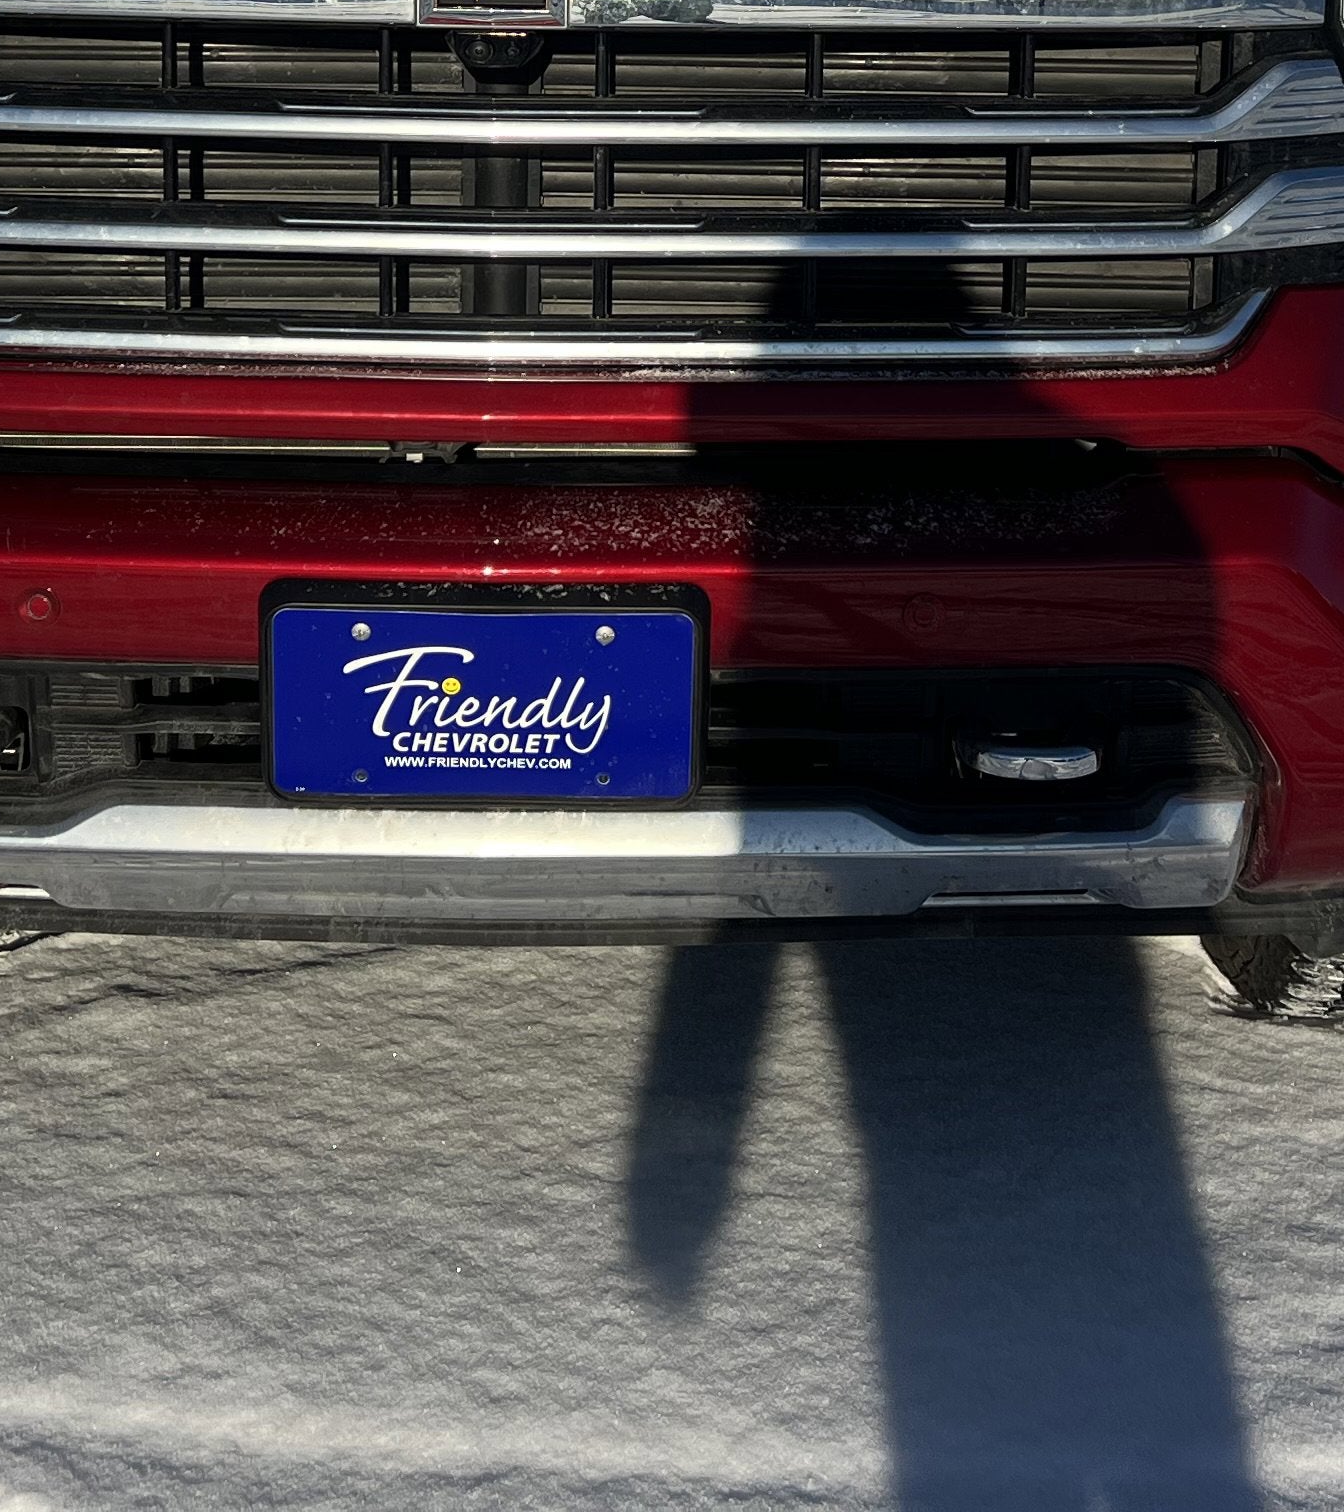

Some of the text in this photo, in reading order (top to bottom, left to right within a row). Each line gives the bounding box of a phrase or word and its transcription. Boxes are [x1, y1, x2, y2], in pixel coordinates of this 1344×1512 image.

[343, 646, 612, 754] Friendly
[392, 731, 561, 755] CHEVROLET
[384, 755, 572, 770] WWW.FRIENDLYCHEV.COM
